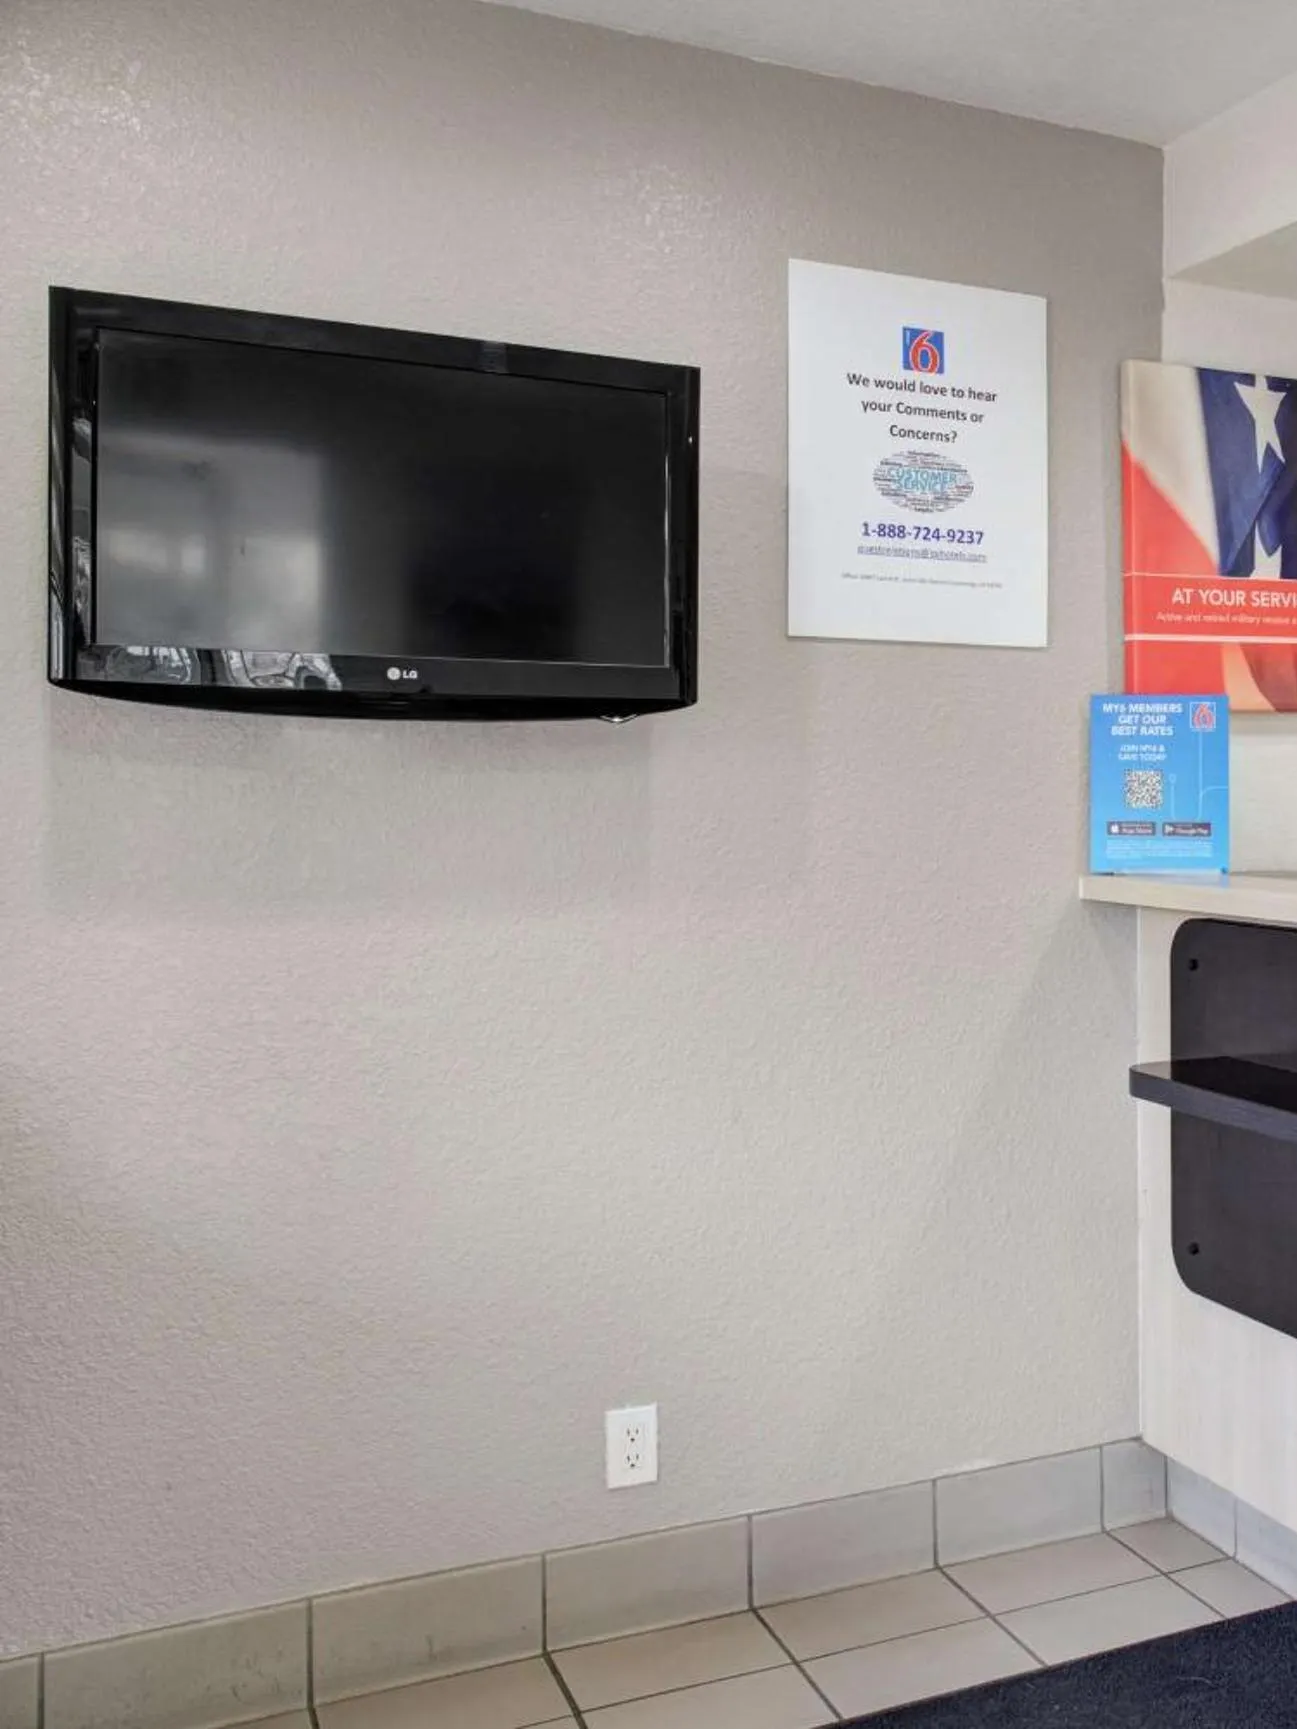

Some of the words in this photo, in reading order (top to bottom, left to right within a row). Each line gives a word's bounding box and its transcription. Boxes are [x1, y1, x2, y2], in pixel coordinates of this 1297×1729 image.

[909, 330, 940, 375] 6
[847, 372, 870, 387] We
[874, 378, 916, 393] would
[920, 381, 948, 397] love
[951, 387, 965, 399] to
[968, 387, 998, 402] hear
[861, 400, 893, 413] your
[896, 402, 967, 421] Comments
[970, 411, 984, 423] or
[889, 424, 958, 444] Concerns?
[862, 521, 984, 545] 1-888-724-9237
[1172, 587, 1194, 605] AT
[1198, 588, 1246, 607] YOUR
[403, 669, 418, 679] LG
[1128, 703, 1183, 713] MEMBERS
[1118, 714, 1140, 725] GET
[1142, 714, 1167, 725] OUR
[1111, 725, 1137, 736] BEST
[1140, 725, 1174, 736] RATES
